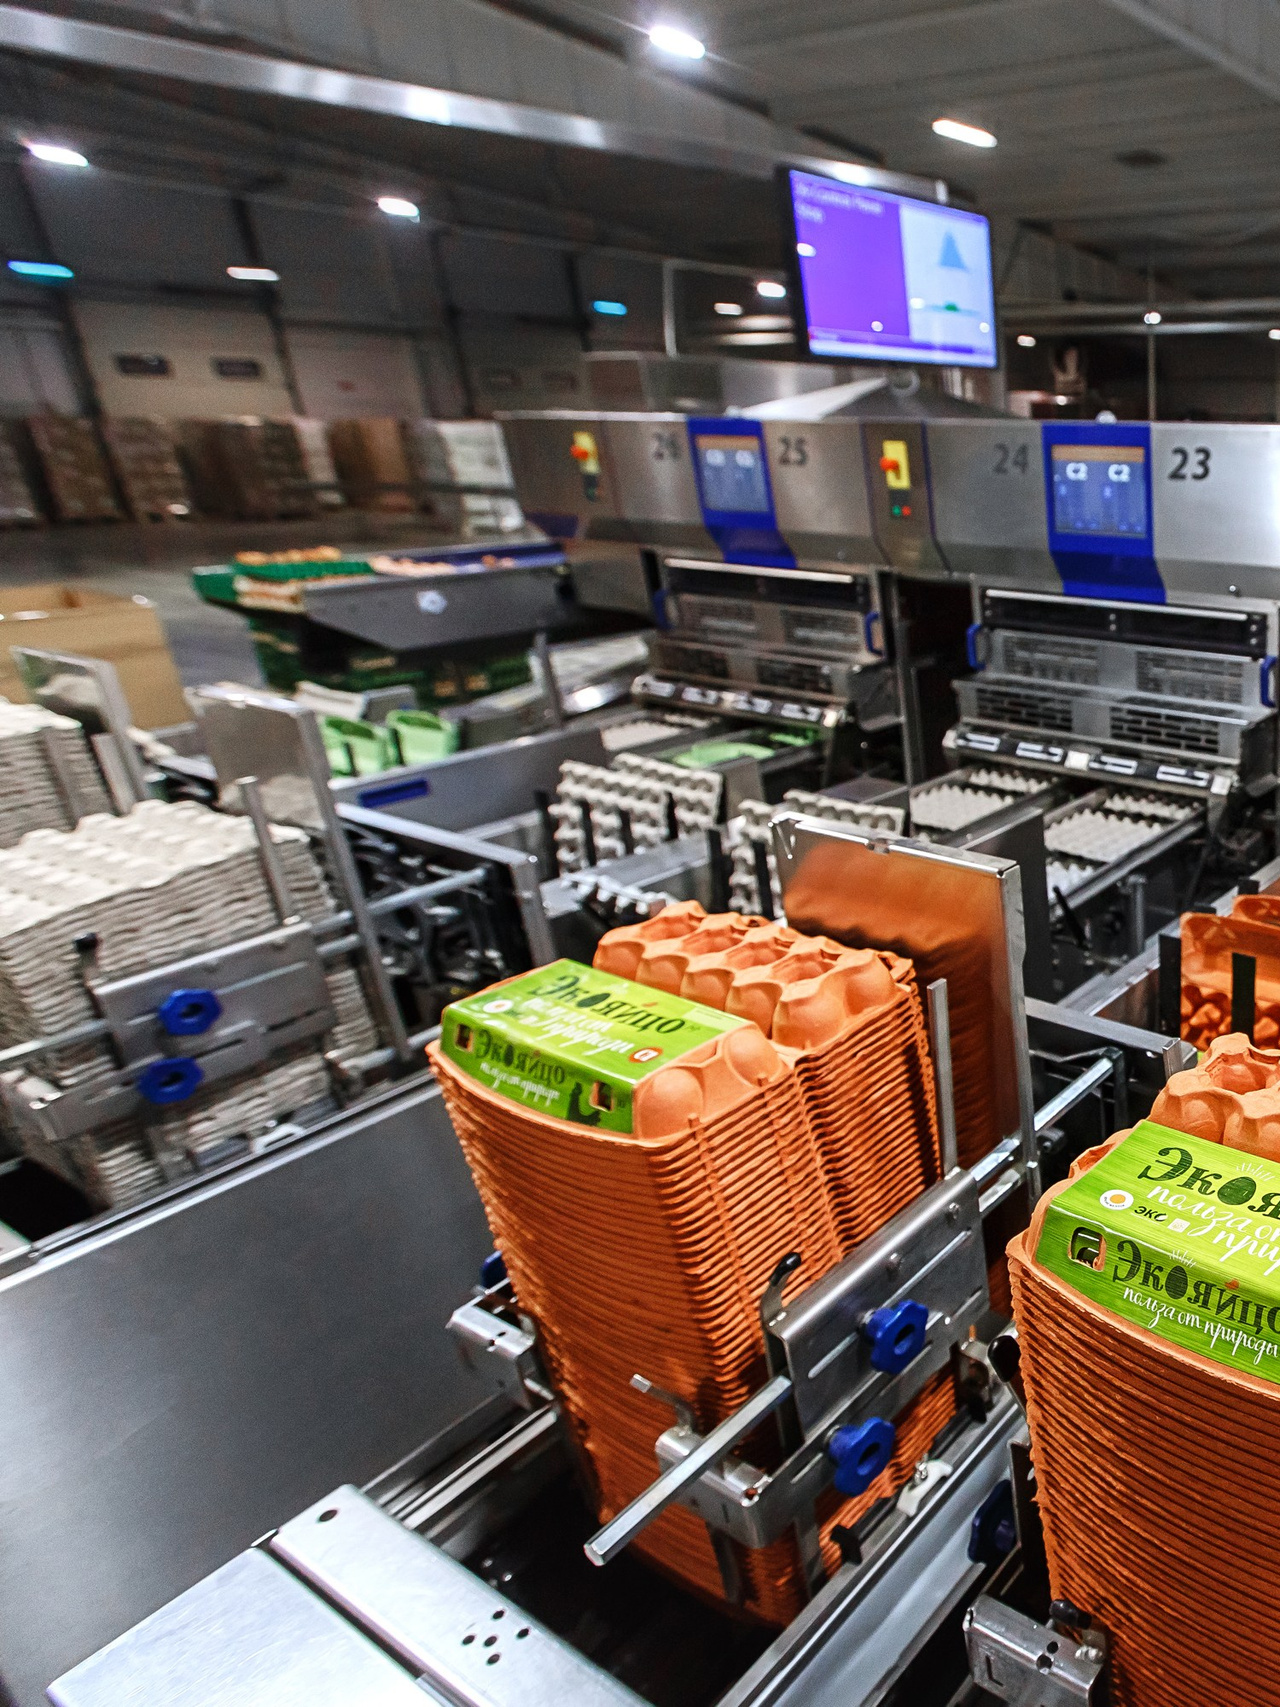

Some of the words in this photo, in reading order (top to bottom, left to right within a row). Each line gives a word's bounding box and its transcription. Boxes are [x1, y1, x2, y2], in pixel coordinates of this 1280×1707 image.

[992, 442, 1029, 475] 24
[1168, 446, 1212, 481] 23
[1146, 1185, 1253, 1236] польза
[1123, 1286, 1175, 1329] польза
[1177, 1311, 1202, 1329] от
[1203, 1320, 1279, 1365] природы
